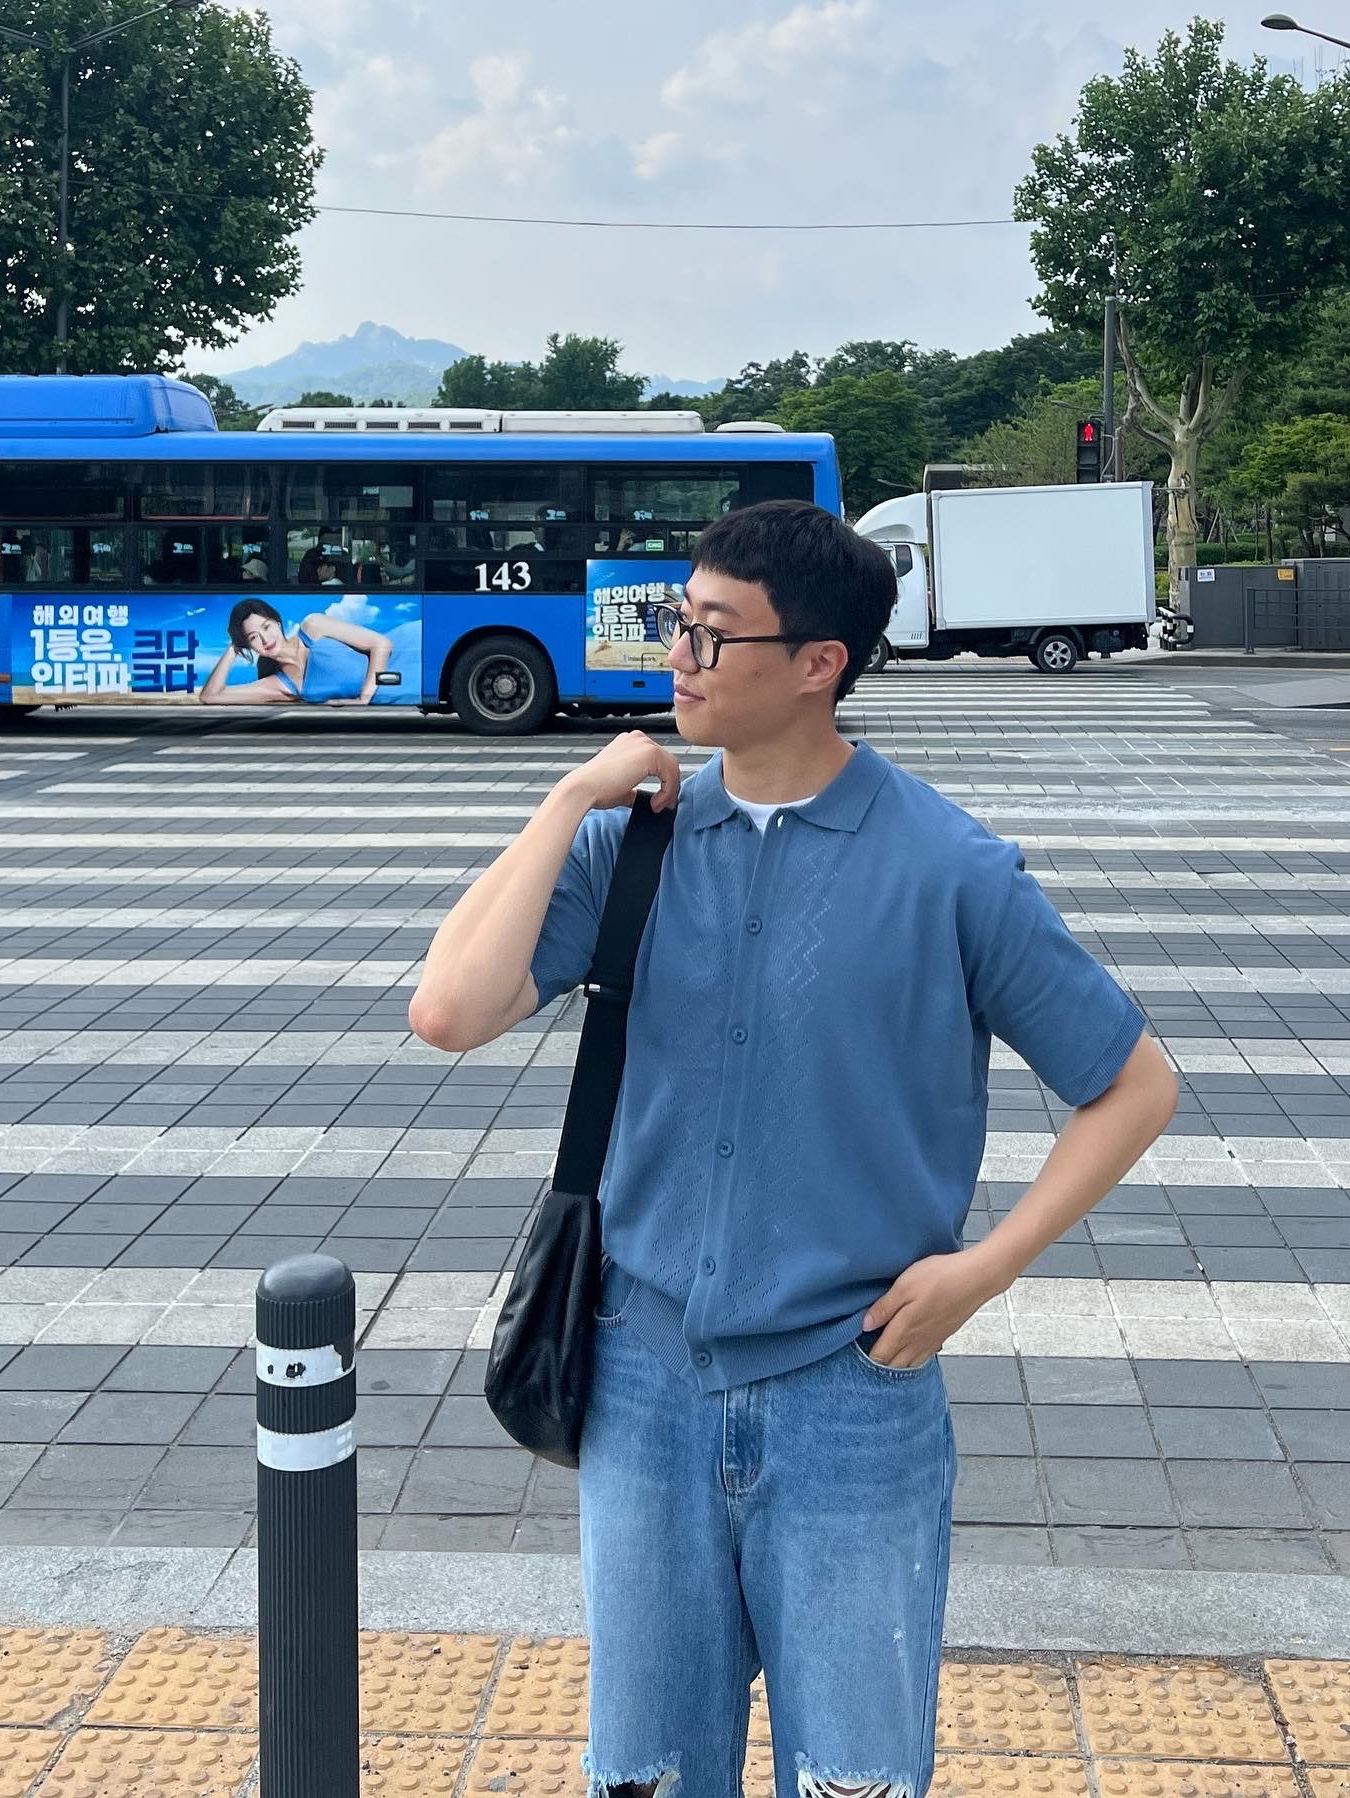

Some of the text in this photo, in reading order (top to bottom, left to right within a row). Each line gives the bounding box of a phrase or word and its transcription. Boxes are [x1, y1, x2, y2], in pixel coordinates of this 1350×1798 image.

[475, 561, 531, 592] 143
[593, 582, 665, 605] 해외여행
[33, 605, 129, 627] 해외여행
[30, 629, 199, 662] 1등은. 크다
